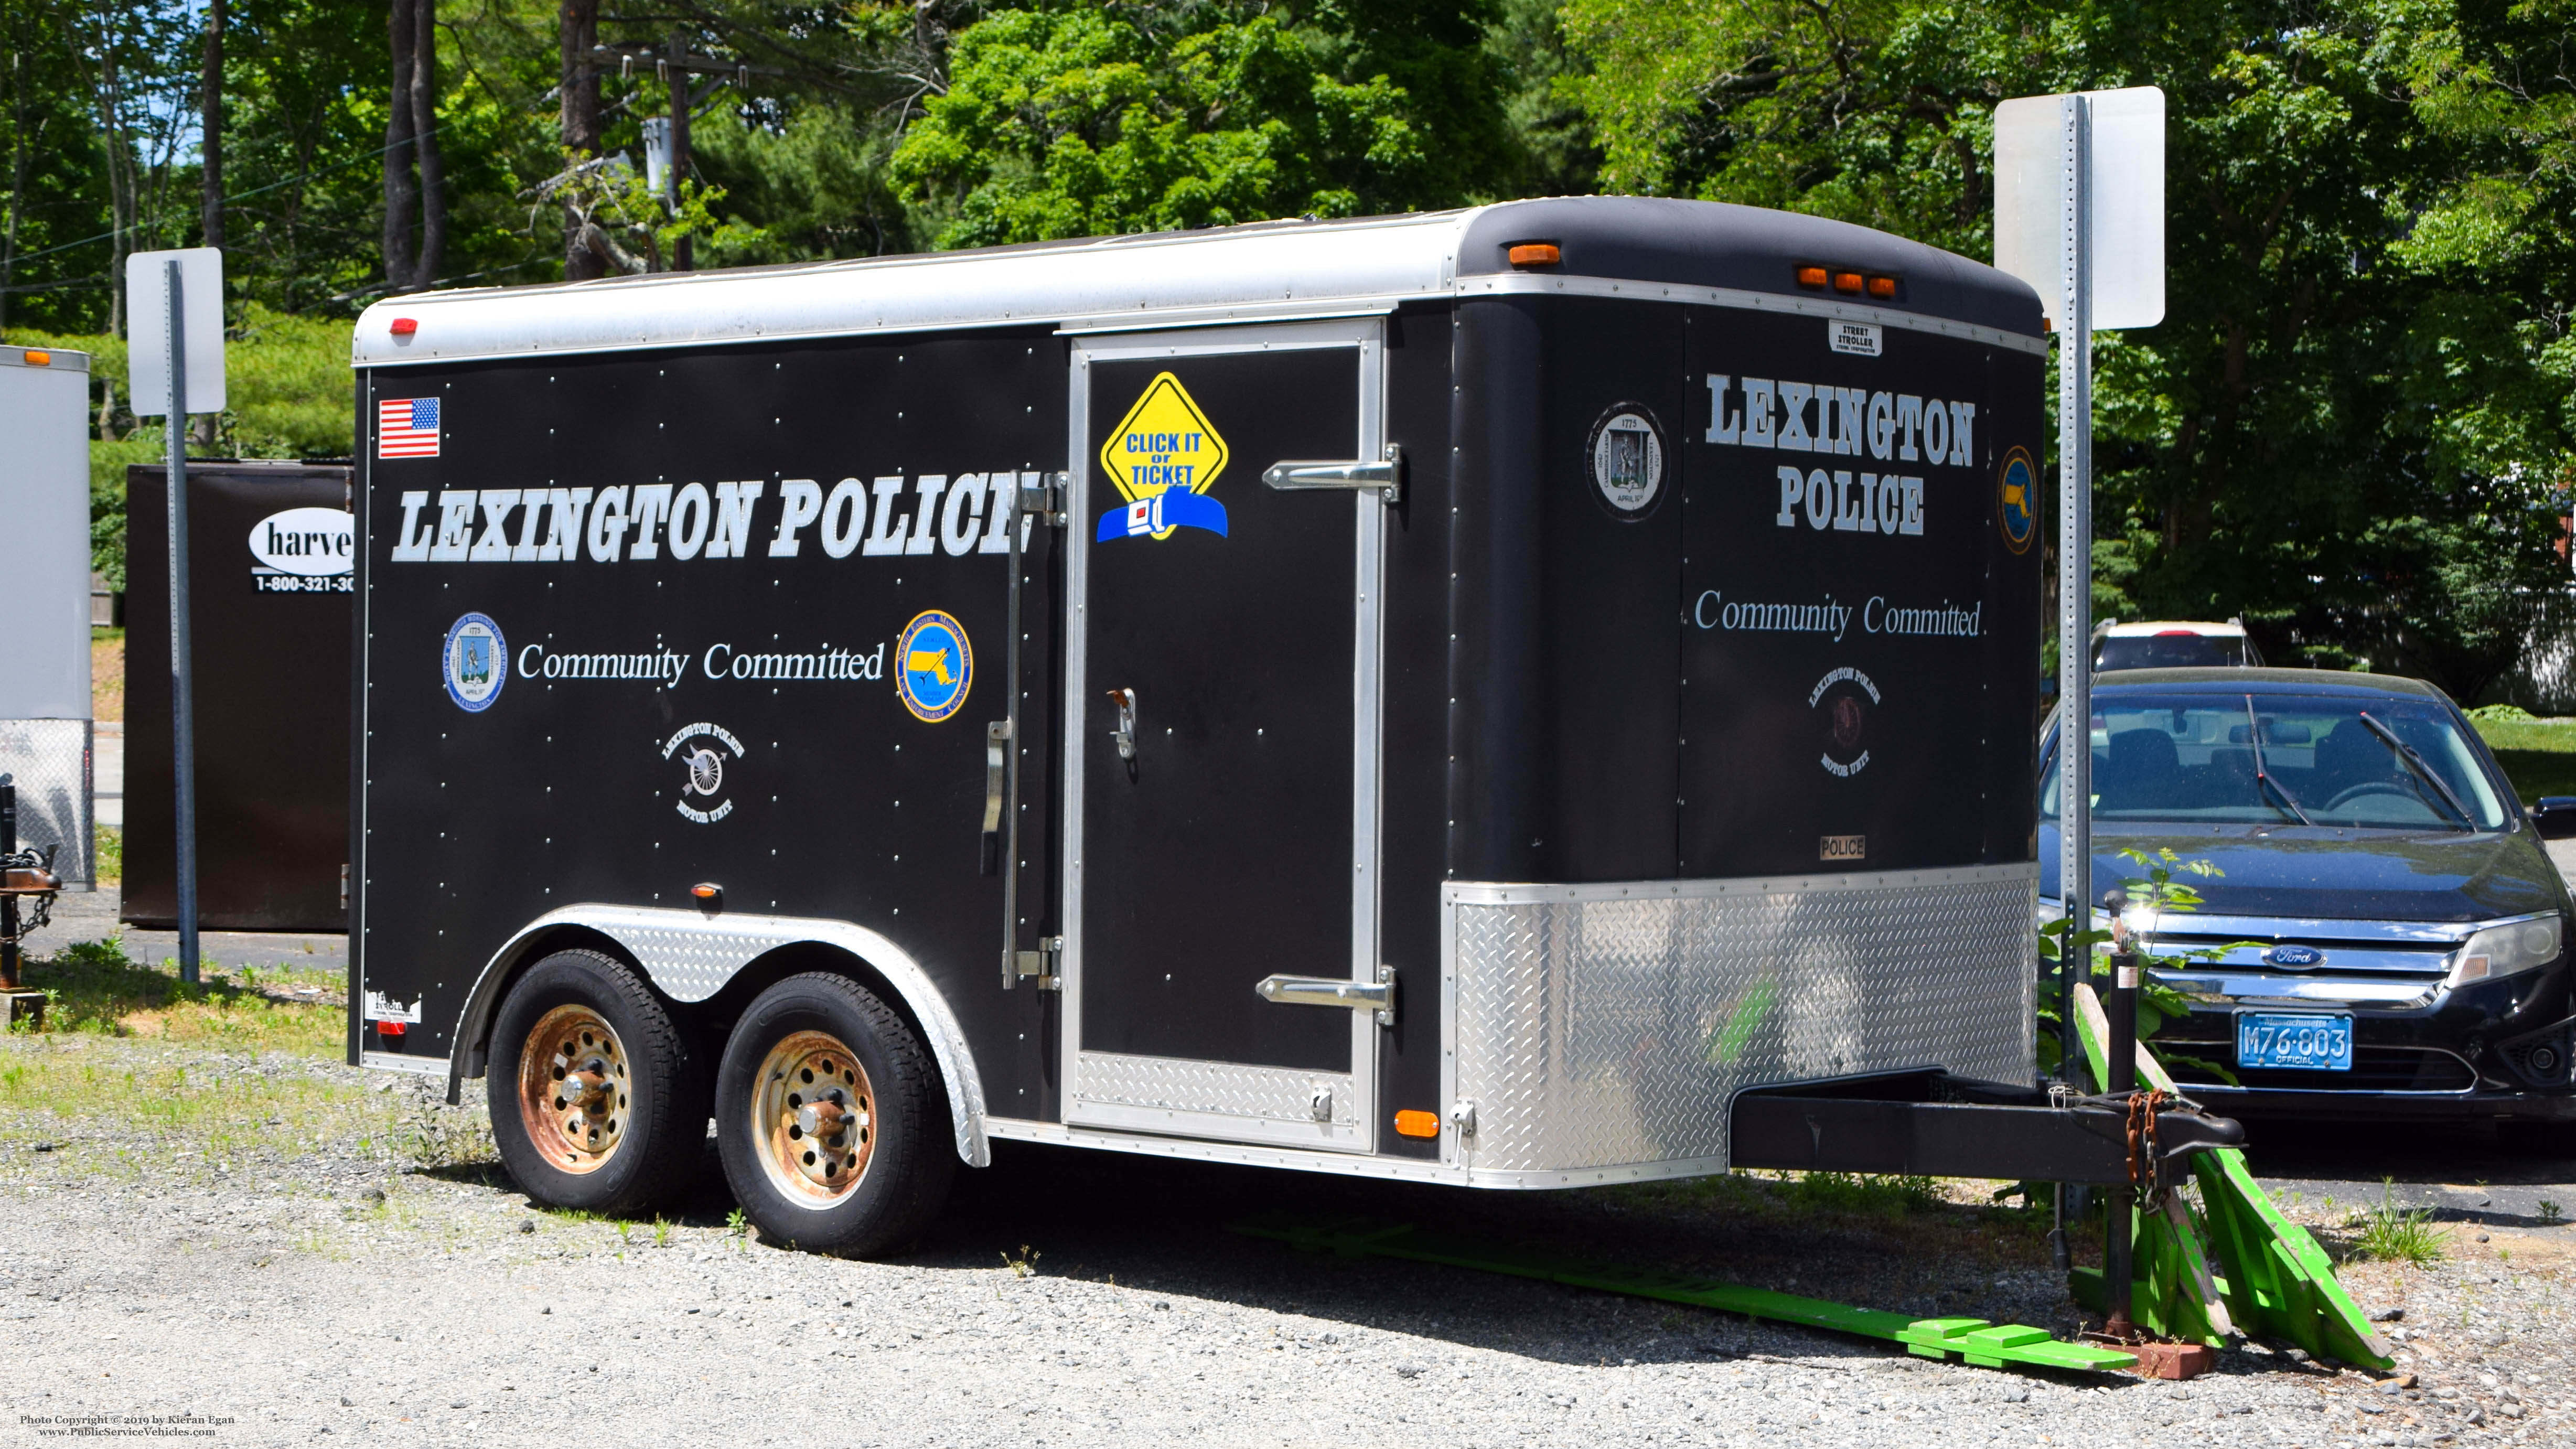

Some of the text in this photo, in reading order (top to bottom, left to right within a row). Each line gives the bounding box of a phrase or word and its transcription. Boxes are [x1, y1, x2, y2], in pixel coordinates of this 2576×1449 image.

[1838, 335, 1873, 347] STROLLER
[1843, 325, 1868, 336] STREET
[1622, 418, 1637, 428] 1775
[1705, 373, 1975, 467] LEXINGTON
[1126, 433, 1202, 453] CLICK IT
[1152, 454, 1171, 464] or
[1131, 466, 1194, 485] TICKET
[1777, 465, 1924, 535] POLICE
[391, 472, 1041, 562] LEXINGTON POLICE
[267, 522, 354, 556] harve
[1695, 590, 1981, 642] Community Committed
[898, 615, 970, 667] NORTH EASTERN MASSACHUSETTS
[518, 643, 690, 689] Community
[704, 642, 885, 680] Committed
[1809, 667, 1881, 708] LEXINGTON POLICE
[662, 722, 745, 760] LEXINGTON POLICE
[1821, 749, 1870, 777] MOTOR UNIT
[677, 798, 733, 823] MOTOR UNIT
[1822, 839, 1864, 855] POLICE
[2277, 949, 2311, 963] Ford
[2264, 1018, 2327, 1026] Massachusetts
[2276, 1055, 2313, 1065] OFFICIAL
